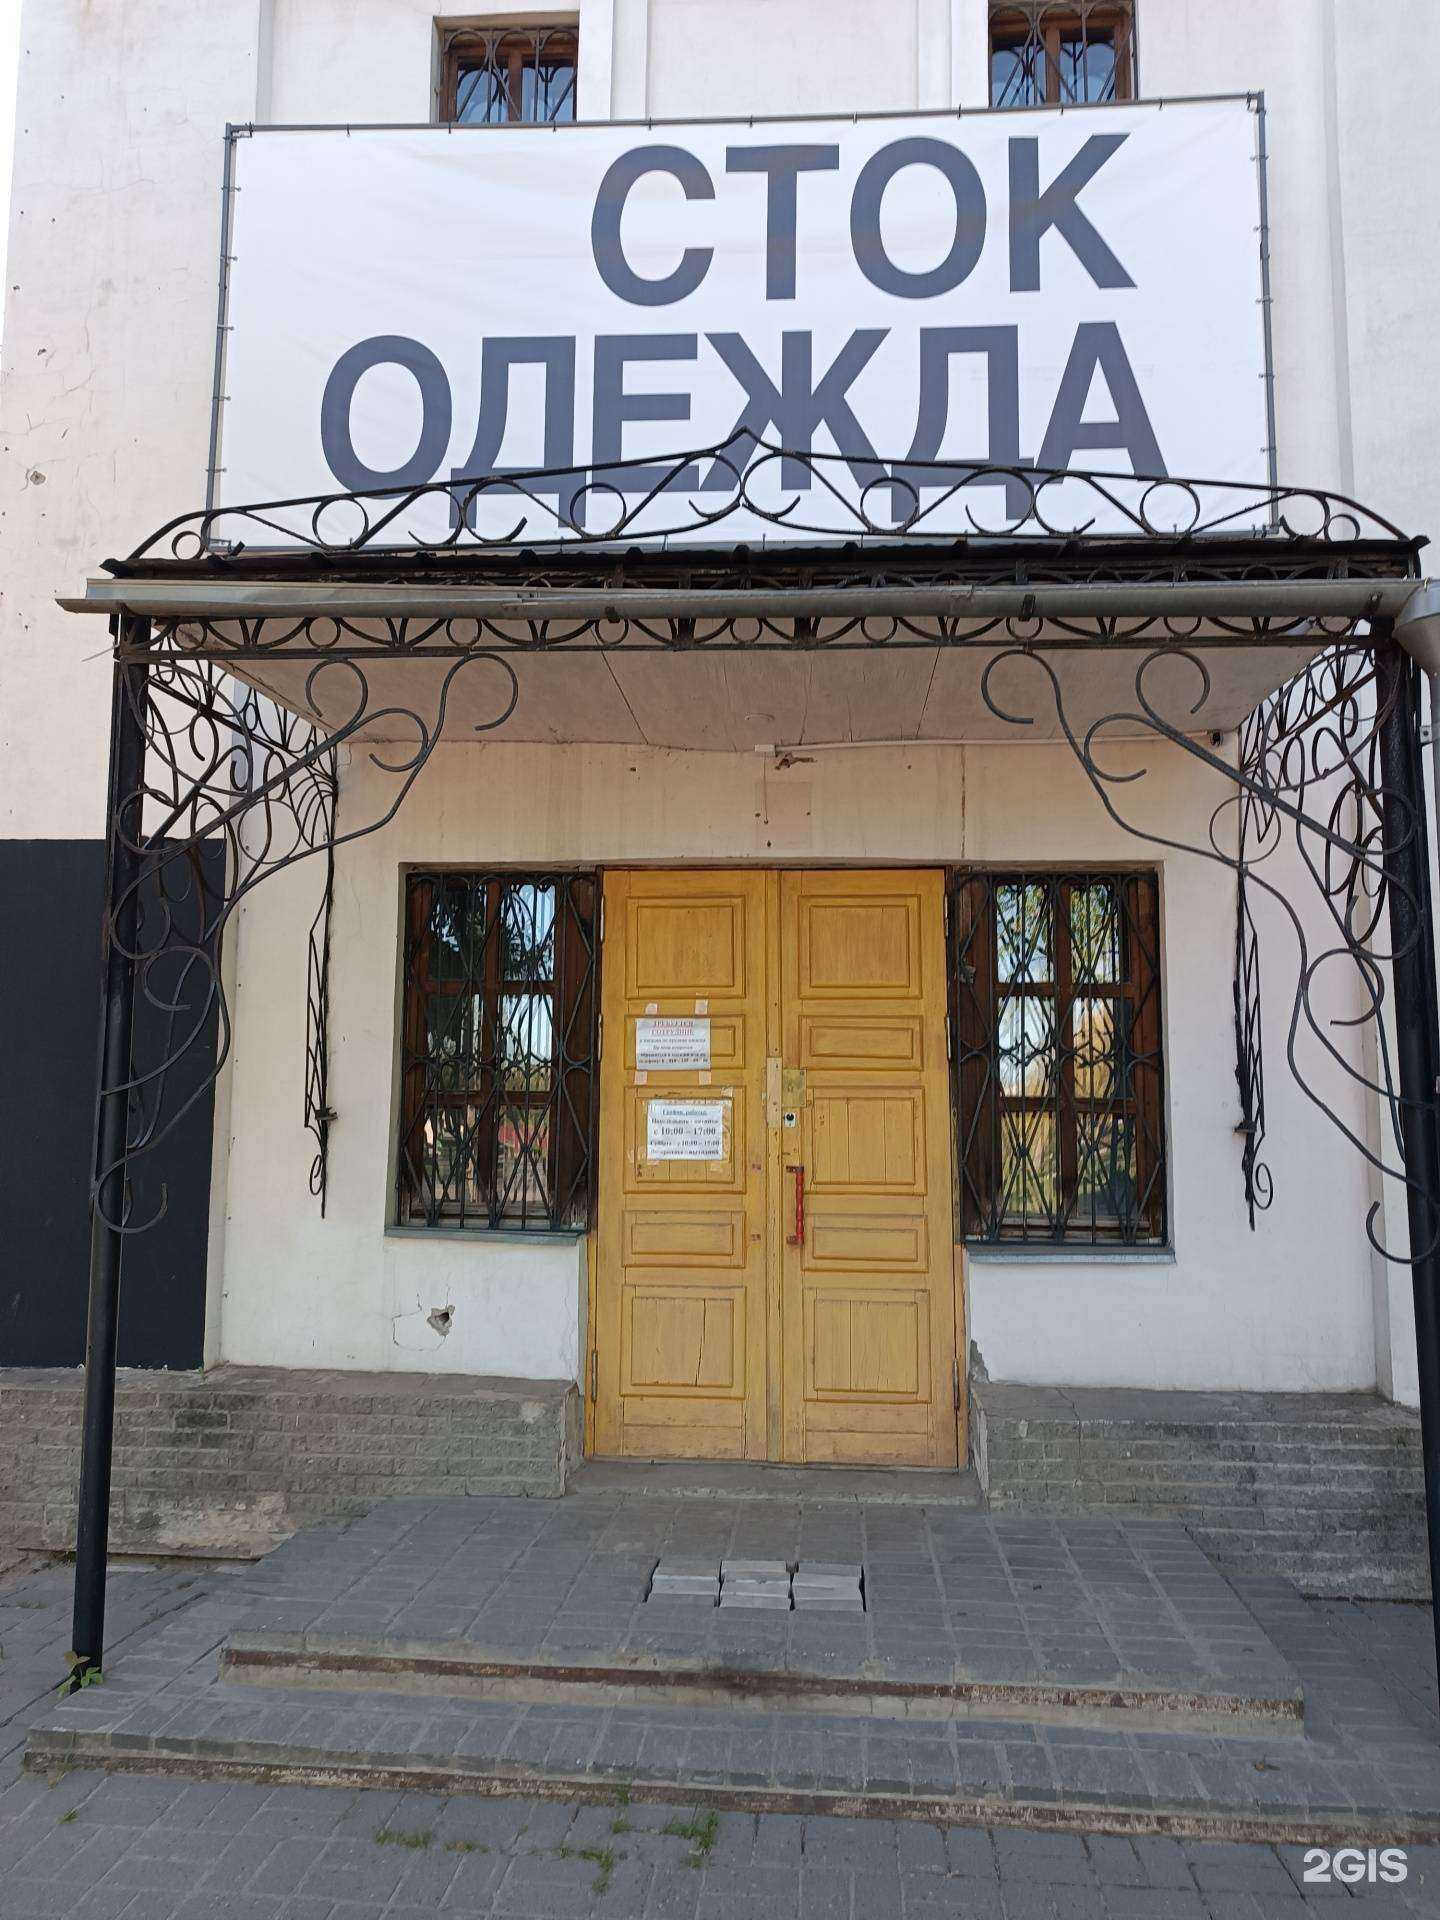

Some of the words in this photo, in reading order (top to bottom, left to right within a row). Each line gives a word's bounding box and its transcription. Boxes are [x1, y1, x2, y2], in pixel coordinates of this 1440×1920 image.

[591, 133, 1137, 307] СТОК
[320, 321, 1171, 529] ОДЕЖДА
[661, 1127, 684, 1136] 10:00
[693, 1127, 716, 1136] 17:00
